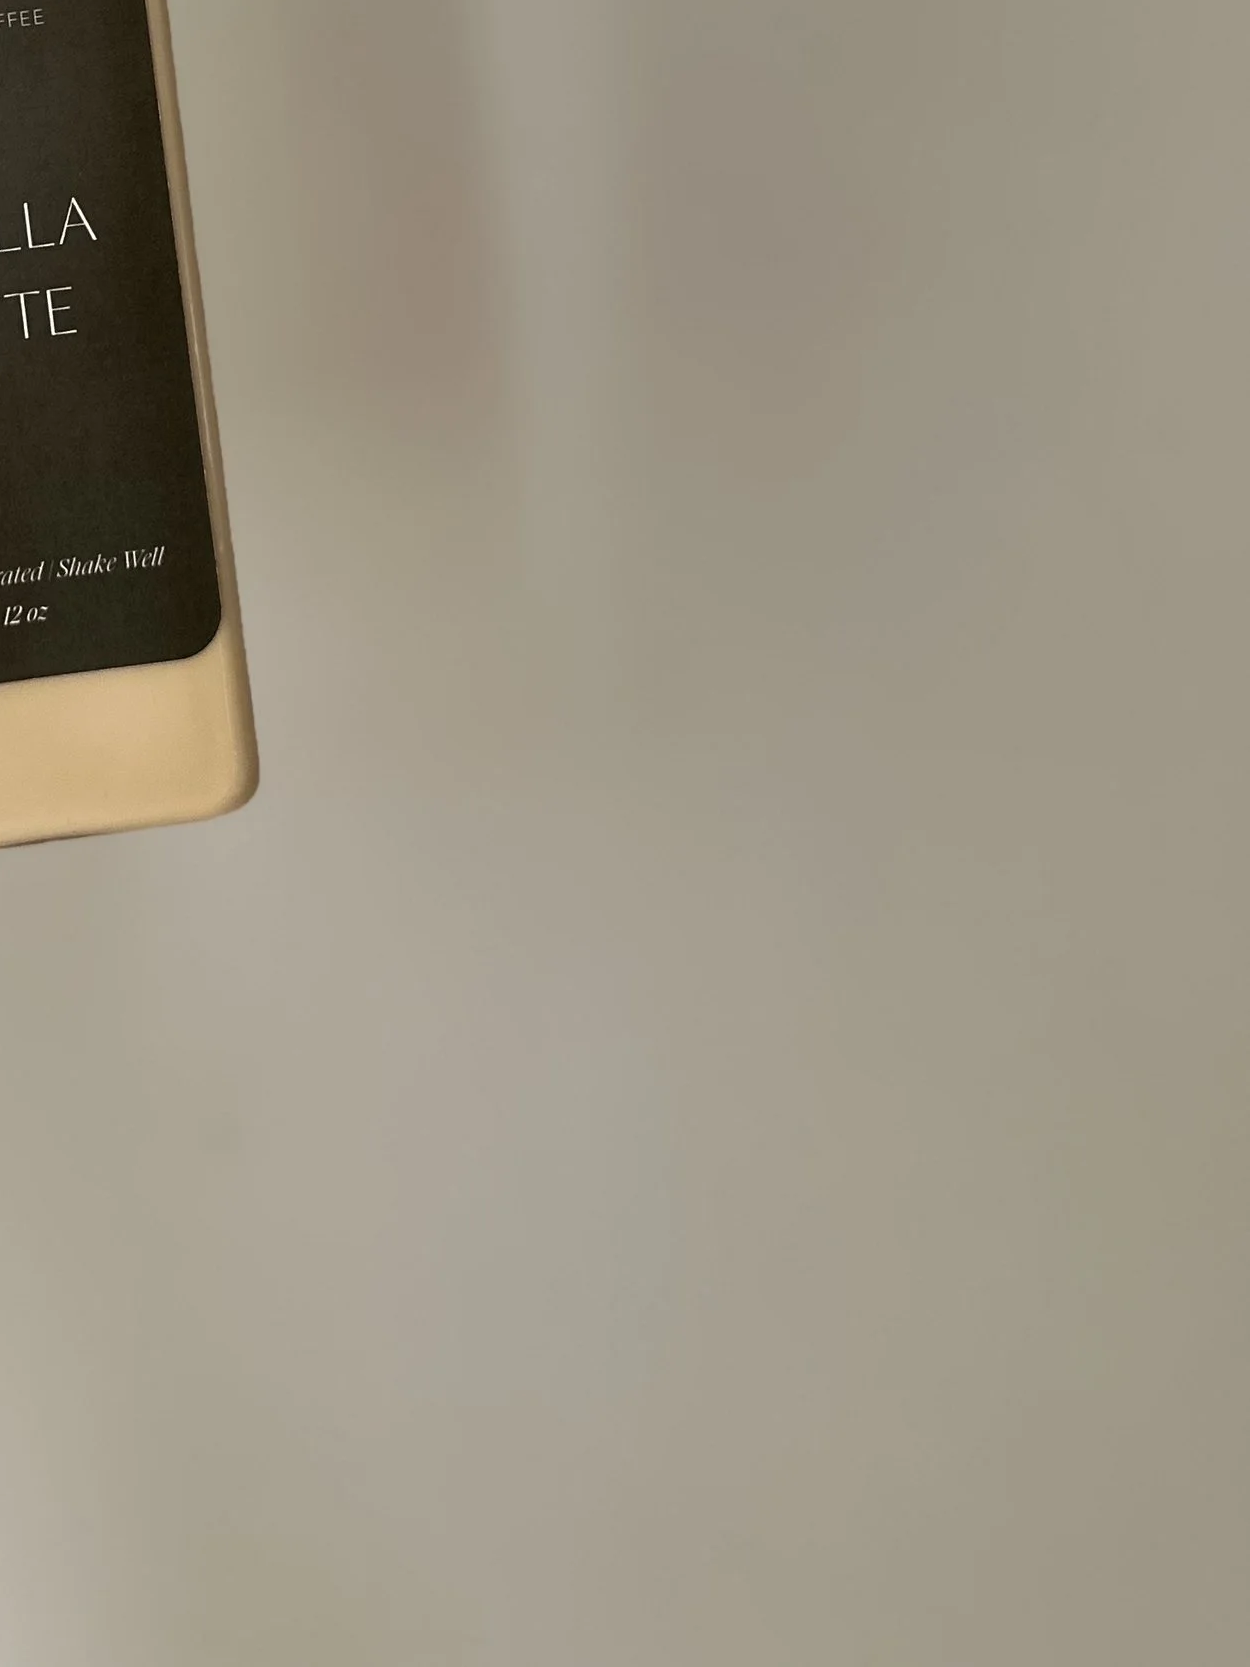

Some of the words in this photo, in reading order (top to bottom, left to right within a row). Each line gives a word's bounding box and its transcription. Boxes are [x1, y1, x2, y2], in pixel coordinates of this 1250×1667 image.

[56, 553, 118, 578] Shake
[124, 545, 166, 570] Well
[3, 604, 23, 626] 12
[26, 605, 49, 622] oz
